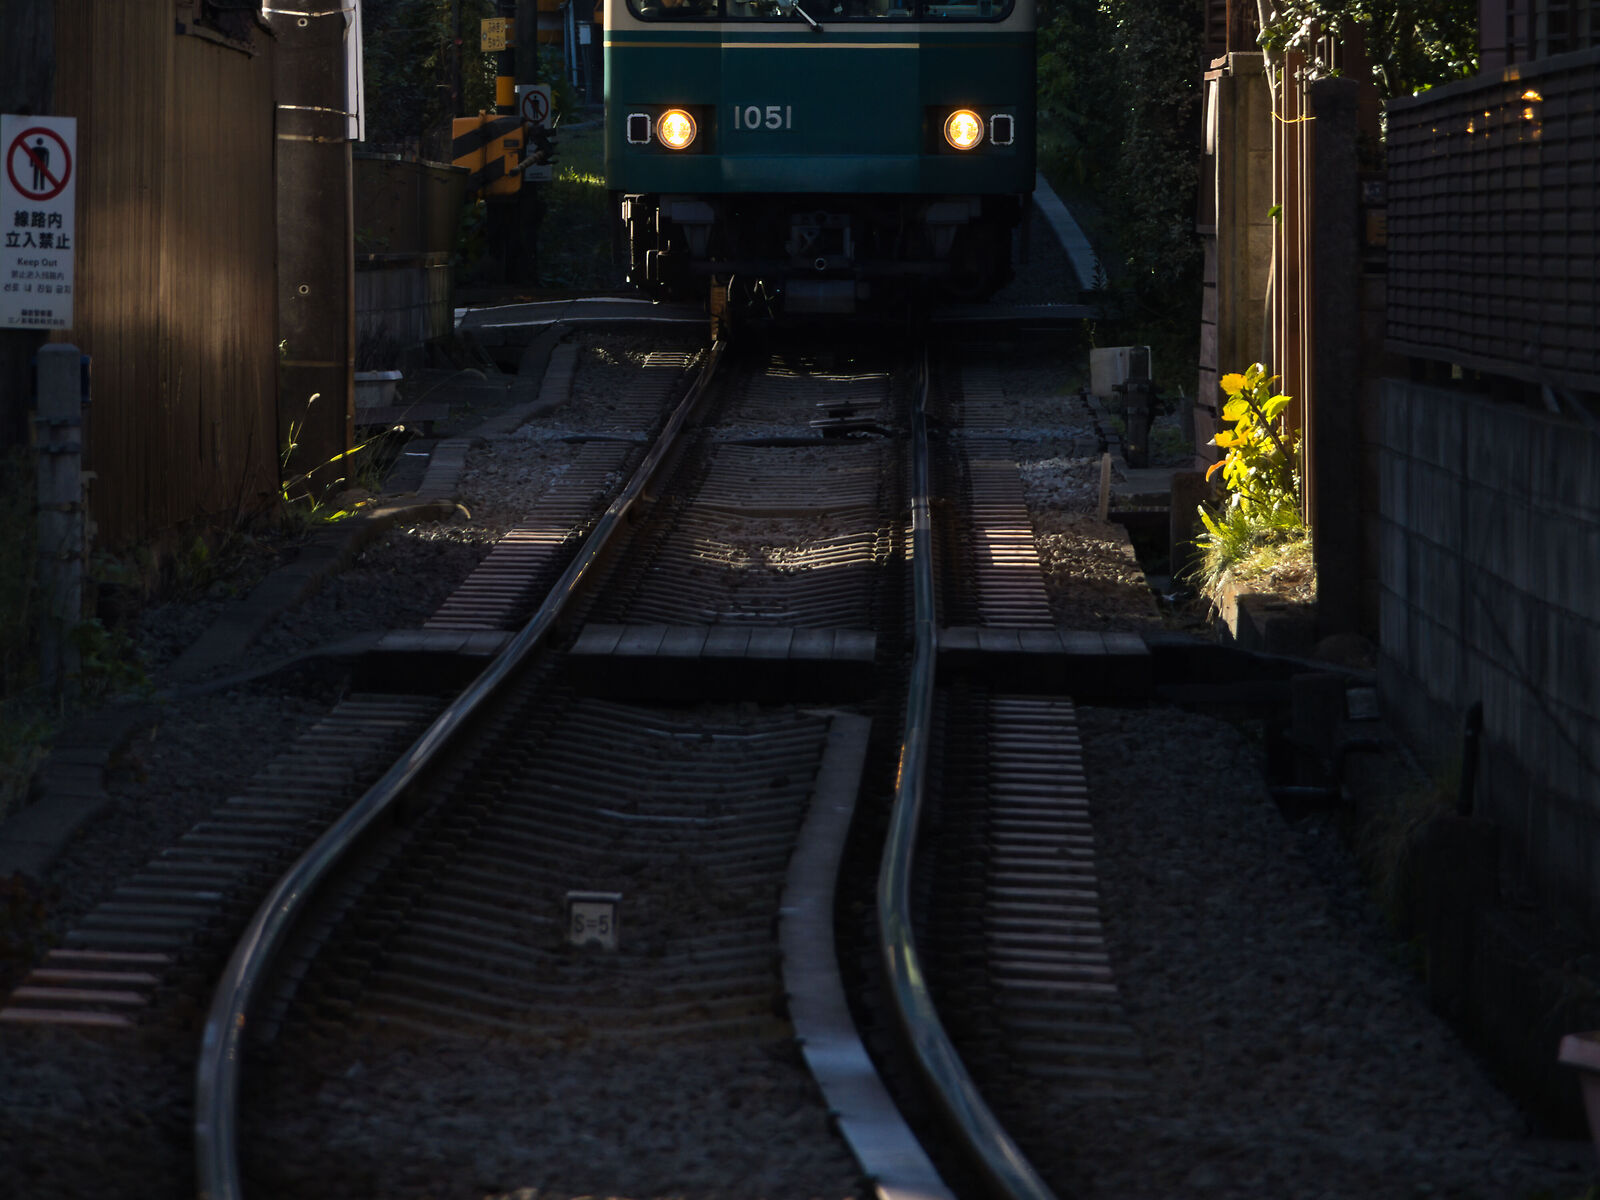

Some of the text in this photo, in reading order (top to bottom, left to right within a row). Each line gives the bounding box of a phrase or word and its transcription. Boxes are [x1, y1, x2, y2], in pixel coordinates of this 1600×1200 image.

[734, 105, 792, 130] 1051
[14, 210, 63, 229] 線路内
[5, 231, 71, 250] 立入禁止
[17, 257, 57, 268] Keep Out
